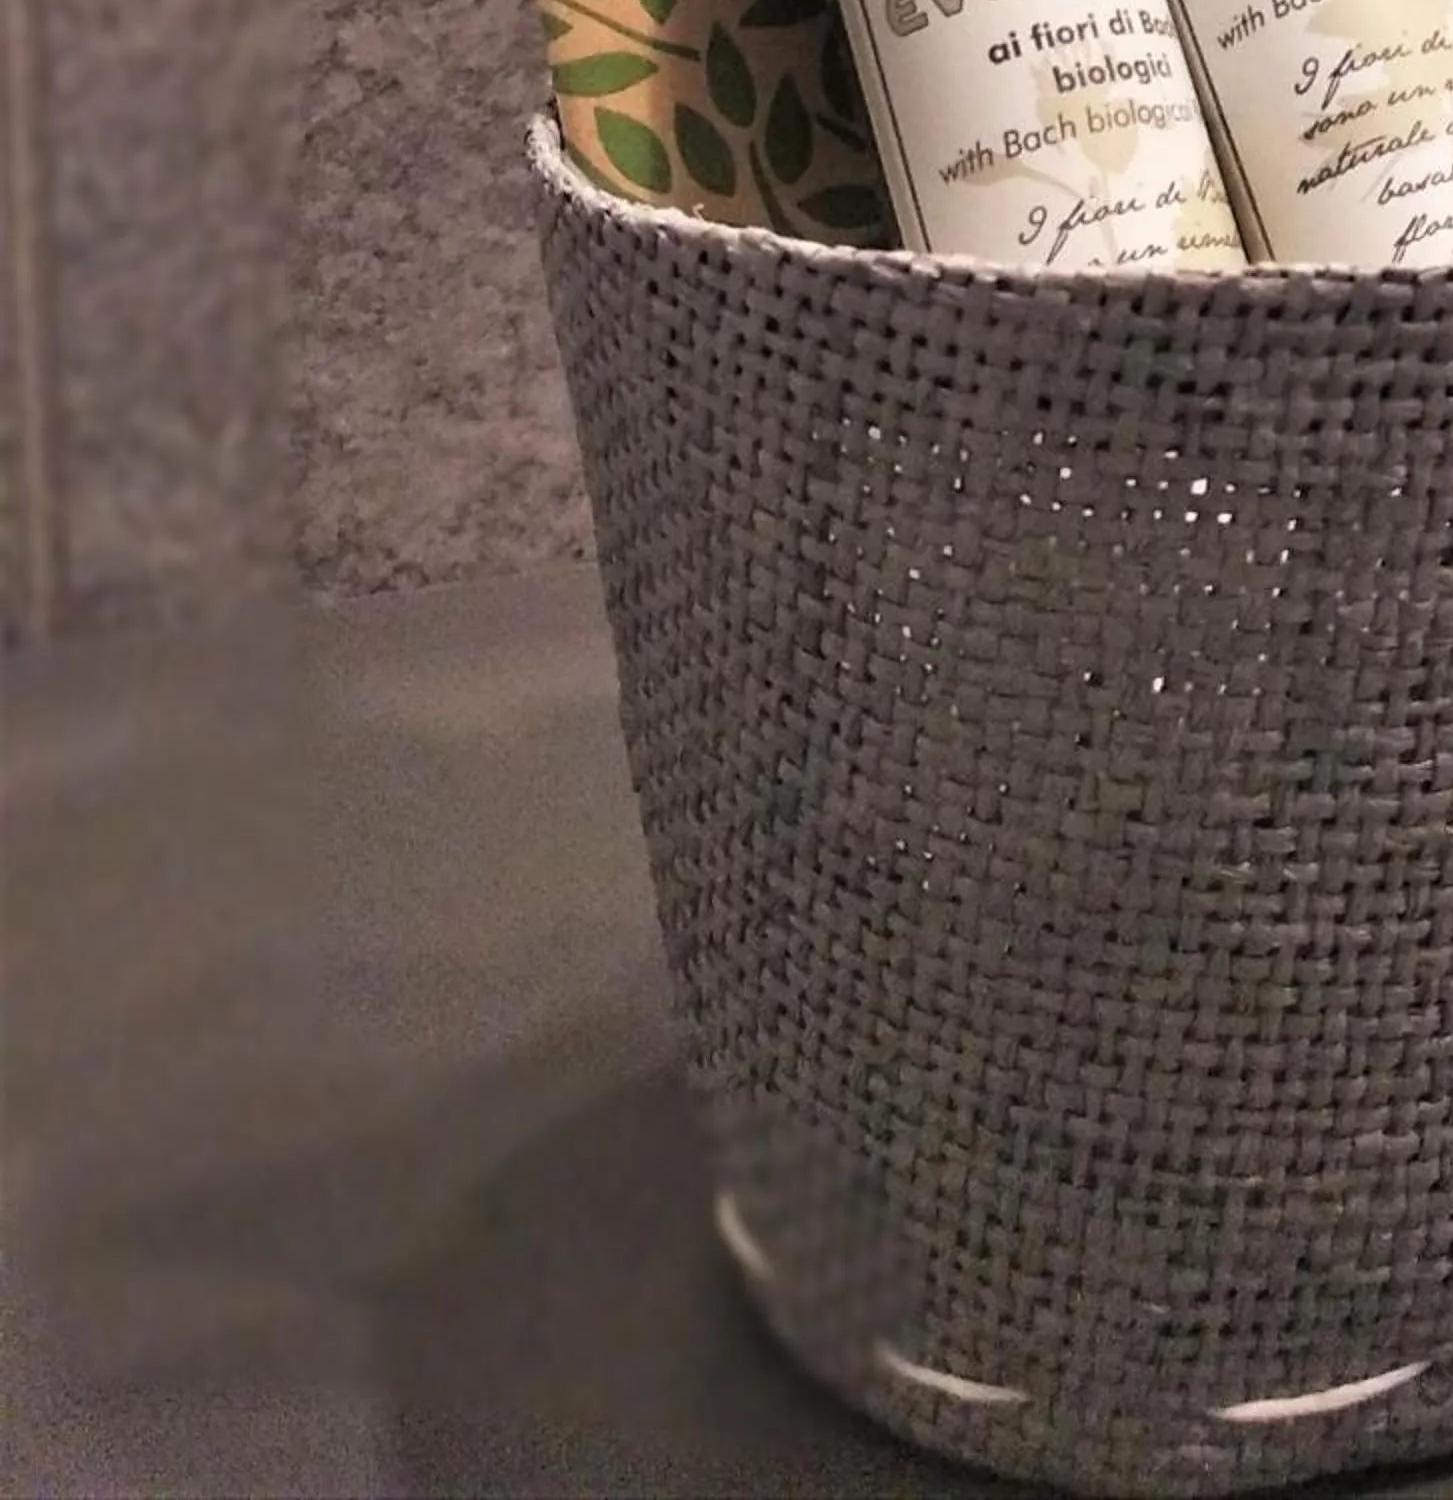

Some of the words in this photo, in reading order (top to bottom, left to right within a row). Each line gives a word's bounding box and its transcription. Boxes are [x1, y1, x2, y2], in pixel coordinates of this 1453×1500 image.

[988, 31, 1023, 65] ai
[1030, 13, 1099, 52] fiori
[1109, 8, 1134, 36] di
[1217, 5, 1266, 50] with
[938, 140, 995, 186] with
[1003, 112, 1078, 161] Bach
